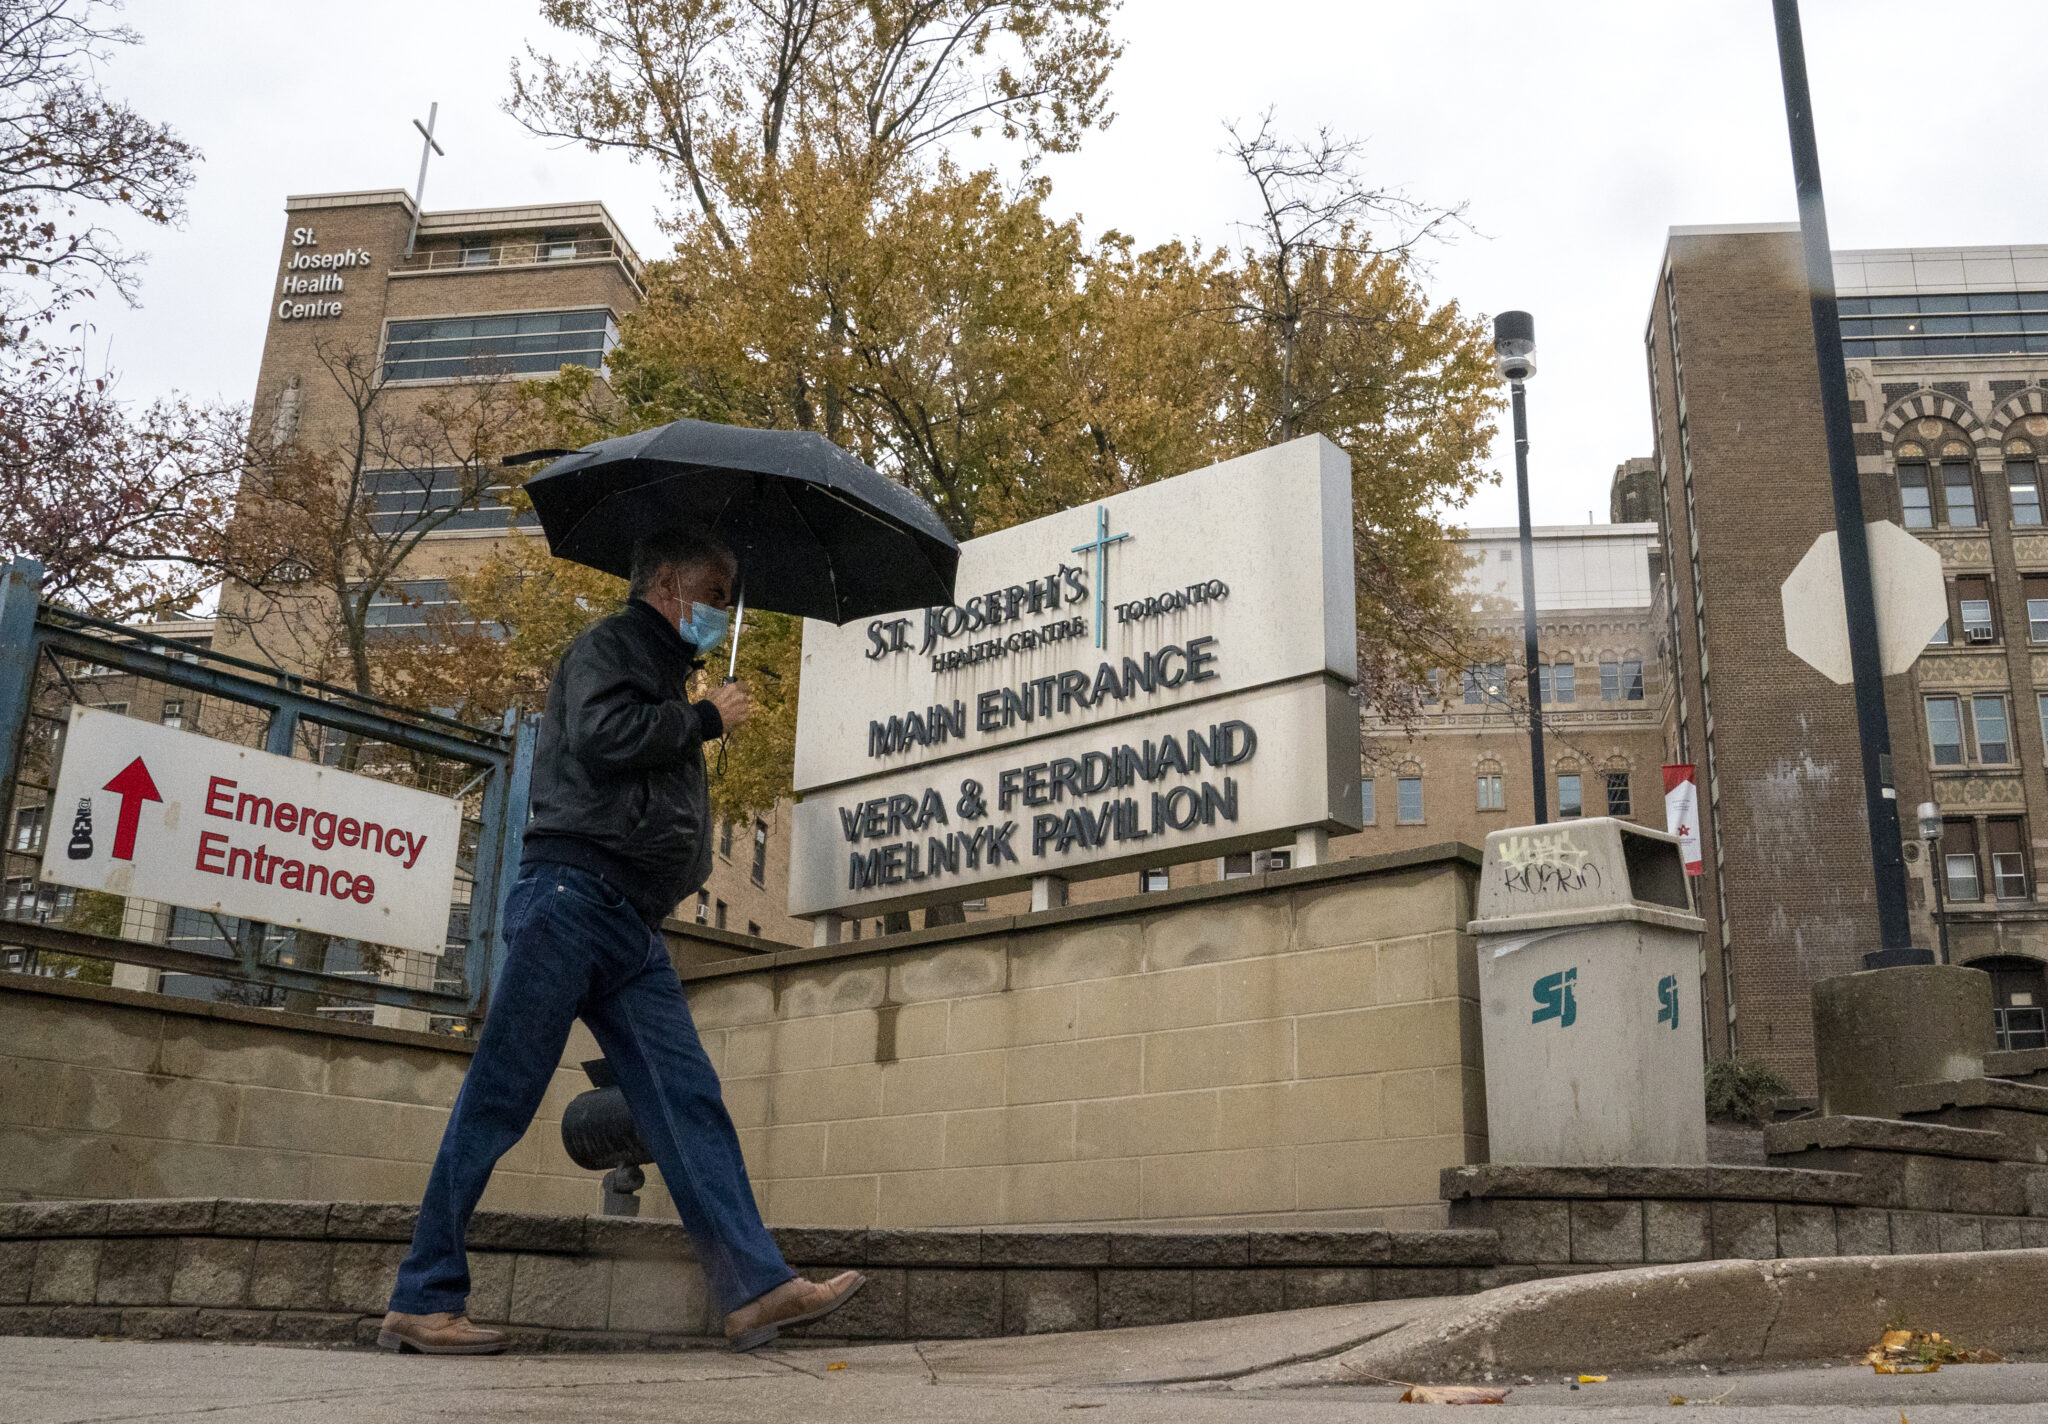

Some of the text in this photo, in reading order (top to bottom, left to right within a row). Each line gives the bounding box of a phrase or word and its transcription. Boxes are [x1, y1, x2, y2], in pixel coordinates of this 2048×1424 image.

[287, 248, 370, 270] Joseph's
[292, 227, 317, 246] St.
[278, 299, 342, 319] Centre
[282, 273, 343, 294] Health
[865, 563, 1085, 660] ST. JOSEPH'S
[1114, 578, 1225, 624] TORONTO
[931, 616, 1083, 673] HEALTH CENTRE
[868, 635, 1215, 757] MAIN ENTRANCE
[838, 719, 1255, 842] VERA & FERDINAND
[204, 775, 428, 869] Emergency
[849, 776, 1233, 890] MELNYK PAVILION
[195, 830, 376, 905] Entrance
